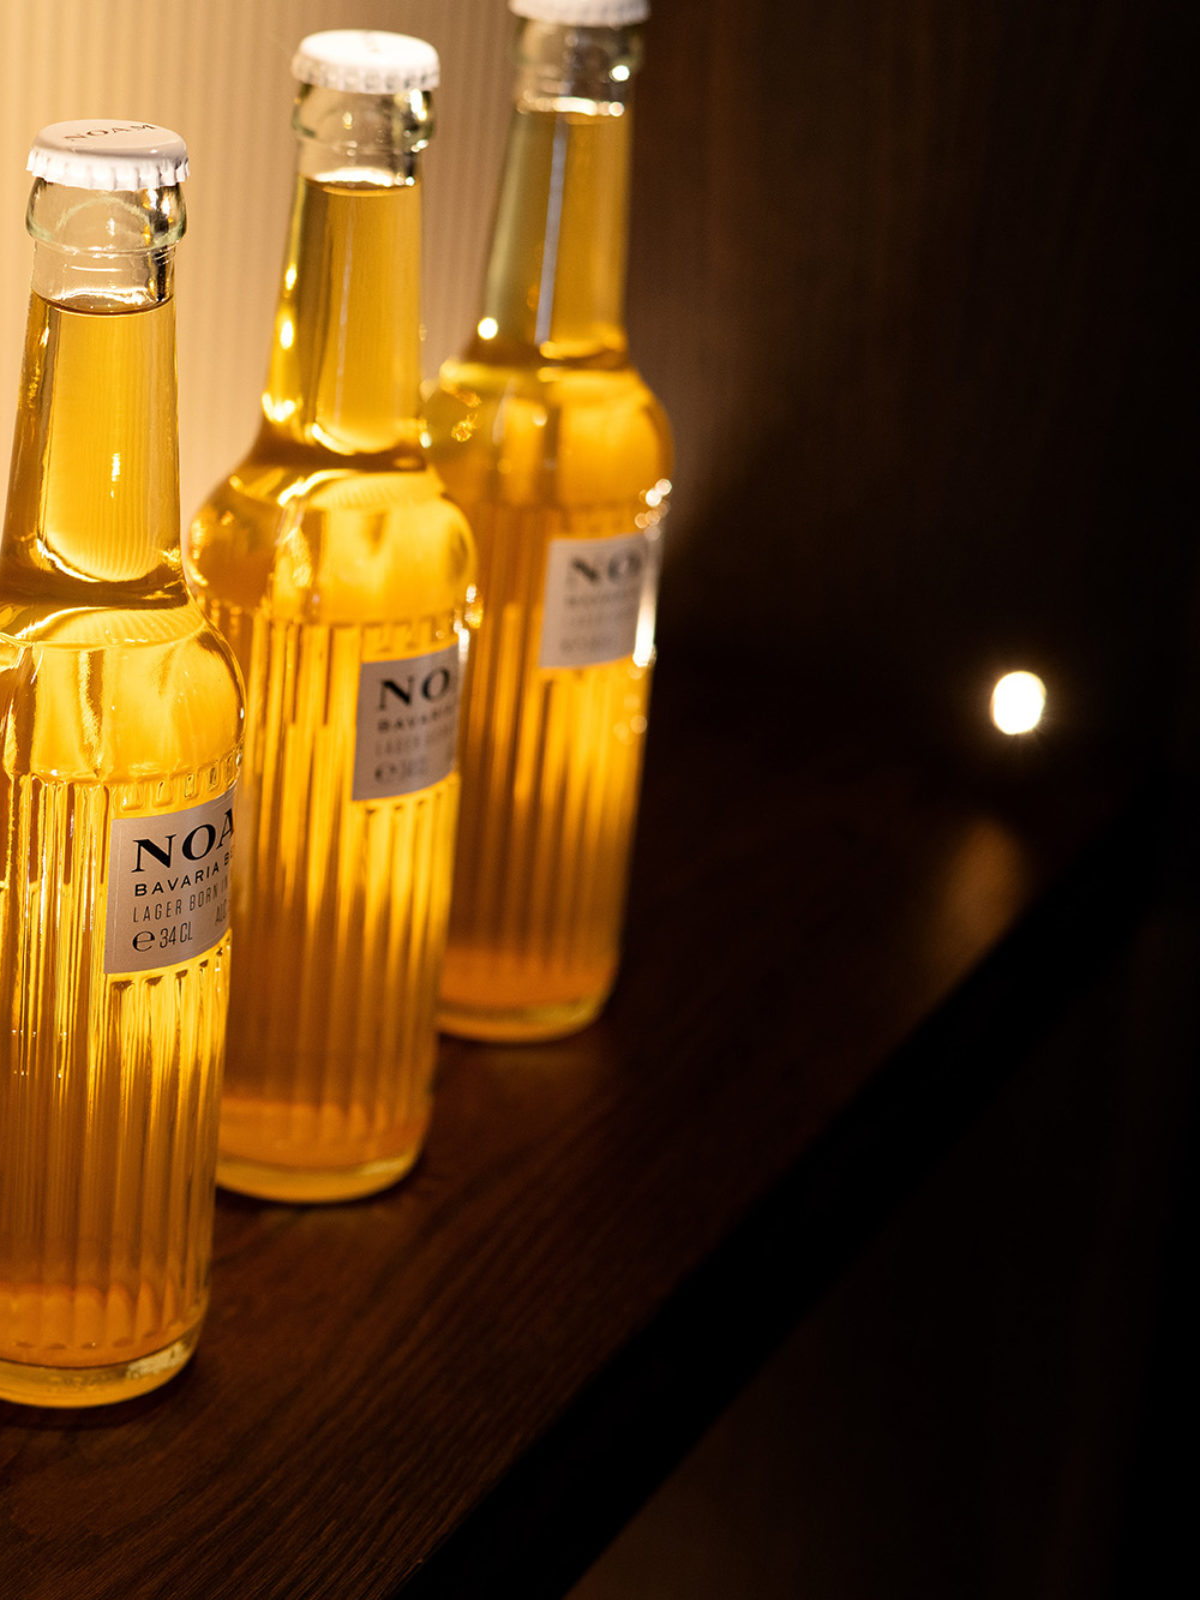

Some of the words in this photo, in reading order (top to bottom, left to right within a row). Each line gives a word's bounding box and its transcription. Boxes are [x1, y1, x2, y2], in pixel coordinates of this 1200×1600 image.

[63, 124, 157, 142] NOAM
[378, 665, 454, 712] NO
[134, 861, 220, 897] BAVARIA
[132, 897, 183, 923] LAGER
[189, 882, 218, 912] BORN
